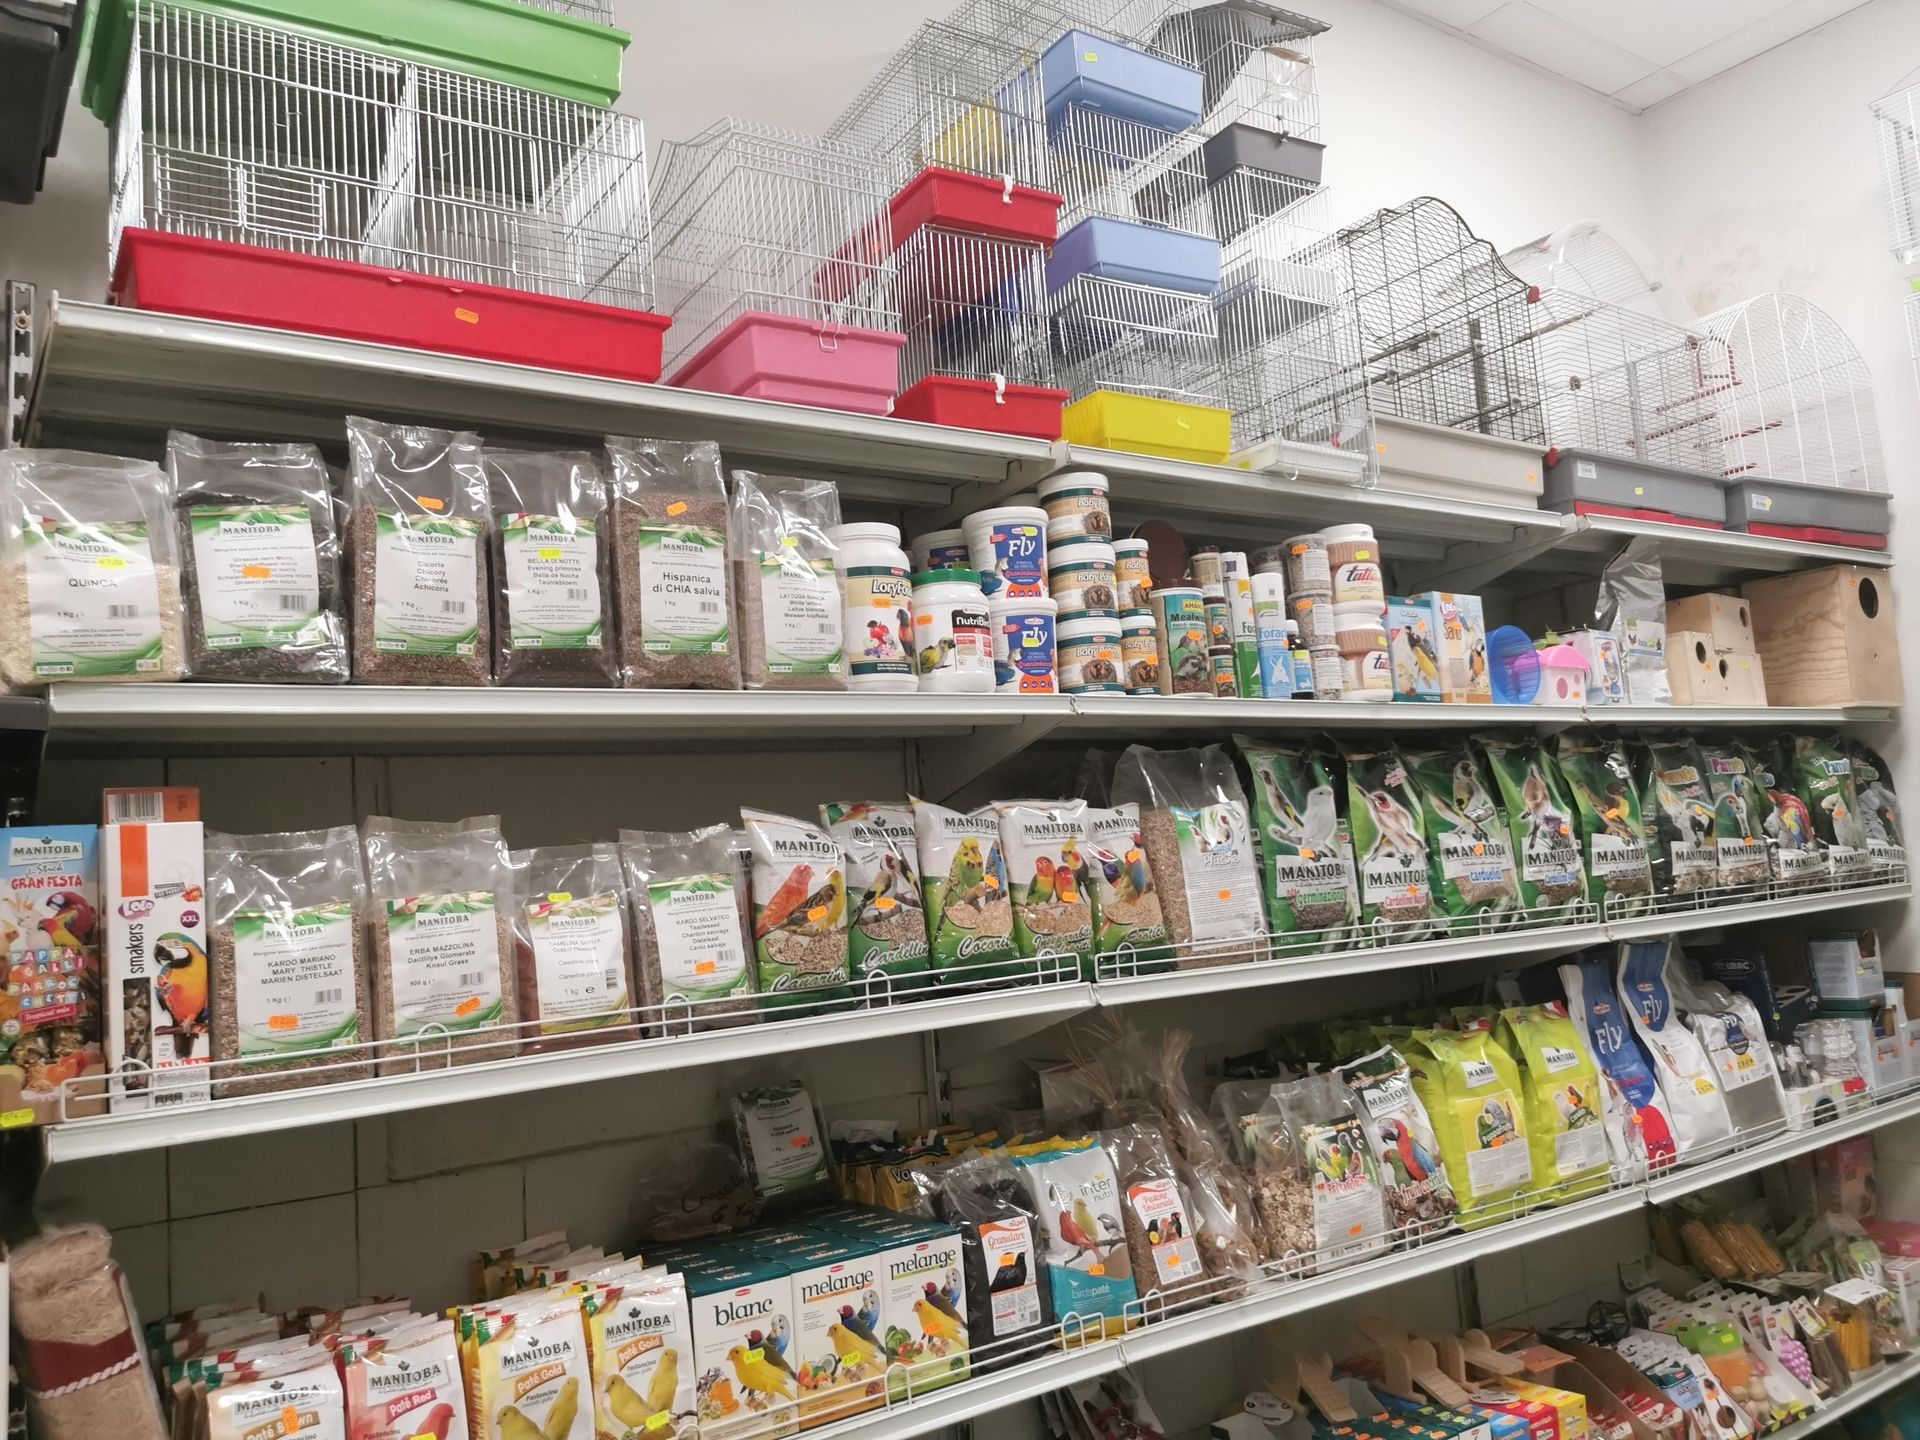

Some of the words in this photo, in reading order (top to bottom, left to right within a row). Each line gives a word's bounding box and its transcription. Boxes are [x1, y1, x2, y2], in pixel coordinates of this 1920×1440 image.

[1078, 498, 1098, 510] Baby
[223, 526, 281, 535] MANITOBA
[663, 542, 704, 553] MANITOBA
[1008, 536, 1036, 557] Fly
[417, 560, 445, 569] Cicoria
[527, 557, 549, 565] BELLA
[559, 557, 580, 566] NOTTE
[1126, 561, 1145, 571] Baby
[416, 568, 446, 578] Chicory
[527, 565, 554, 573] Evening
[555, 565, 582, 573] primrose
[663, 571, 712, 584] Hispanica
[1078, 573, 1098, 583] Baby
[414, 583, 449, 593] Achicoria
[653, 583, 664, 593] di
[665, 584, 692, 595] CHIA
[694, 585, 721, 597] salvia
[1076, 646, 1098, 657] Baby
[1125, 640, 1144, 650] Baby
[853, 826, 915, 838] MANITOBA
[1024, 823, 1084, 835] MANITOBA
[13, 845, 81, 856] MANITOBA
[11, 876, 46, 890] GRAN
[47, 875, 84, 887] FESTA
[673, 893, 716, 904] MANITOBA
[181, 914, 199, 923] XXL
[418, 915, 470, 929] MANITOBA
[551, 918, 597, 929] MANITOBA
[676, 918, 698, 926] KARDO
[698, 914, 730, 923] SELVATICO
[682, 931, 705, 939] Chardon
[705, 928, 729, 937] sauvage
[125, 922, 145, 974] smakers
[409, 947, 431, 956] ERBA
[432, 941, 475, 953] MAZZOLINA
[267, 959, 298, 968] KARDO
[300, 954, 337, 964] MARIANO
[440, 950, 476, 960] Glomerata
[272, 967, 296, 976] MARY
[300, 963, 333, 972] THISTLE
[426, 960, 447, 969] Knaul
[449, 958, 469, 967] Grass
[261, 976, 294, 985] MARIEN
[295, 969, 343, 981] DISTELSAAT
[571, 988, 580, 997] kg
[25, 1008, 57, 1021] Tropical
[57, 1005, 71, 1015] mix
[1642, 994, 1663, 1022] Fly
[1595, 1021, 1623, 1055] Fly
[1546, 1051, 1576, 1064] MANITOBA
[1078, 1177, 1112, 1198] inter
[1093, 1190, 1113, 1202] nutri
[889, 1249, 957, 1281] melange
[801, 1269, 874, 1304] melange
[1071, 1282, 1110, 1299] birdspaté
[714, 1298, 774, 1327] blanc
[605, 1317, 672, 1337] MANITOBA
[502, 1341, 572, 1367] MANITOBA
[619, 1345, 638, 1364] Paté
[639, 1337, 660, 1354] Gold
[370, 1365, 441, 1388] MANITOBA
[517, 1374, 540, 1394] Paté
[540, 1364, 564, 1381] Gold
[236, 1385, 321, 1413] MANITOBA
[388, 1399, 411, 1416] Paté
[412, 1391, 432, 1407] Red
[276, 1412, 313, 1433] Bwn
